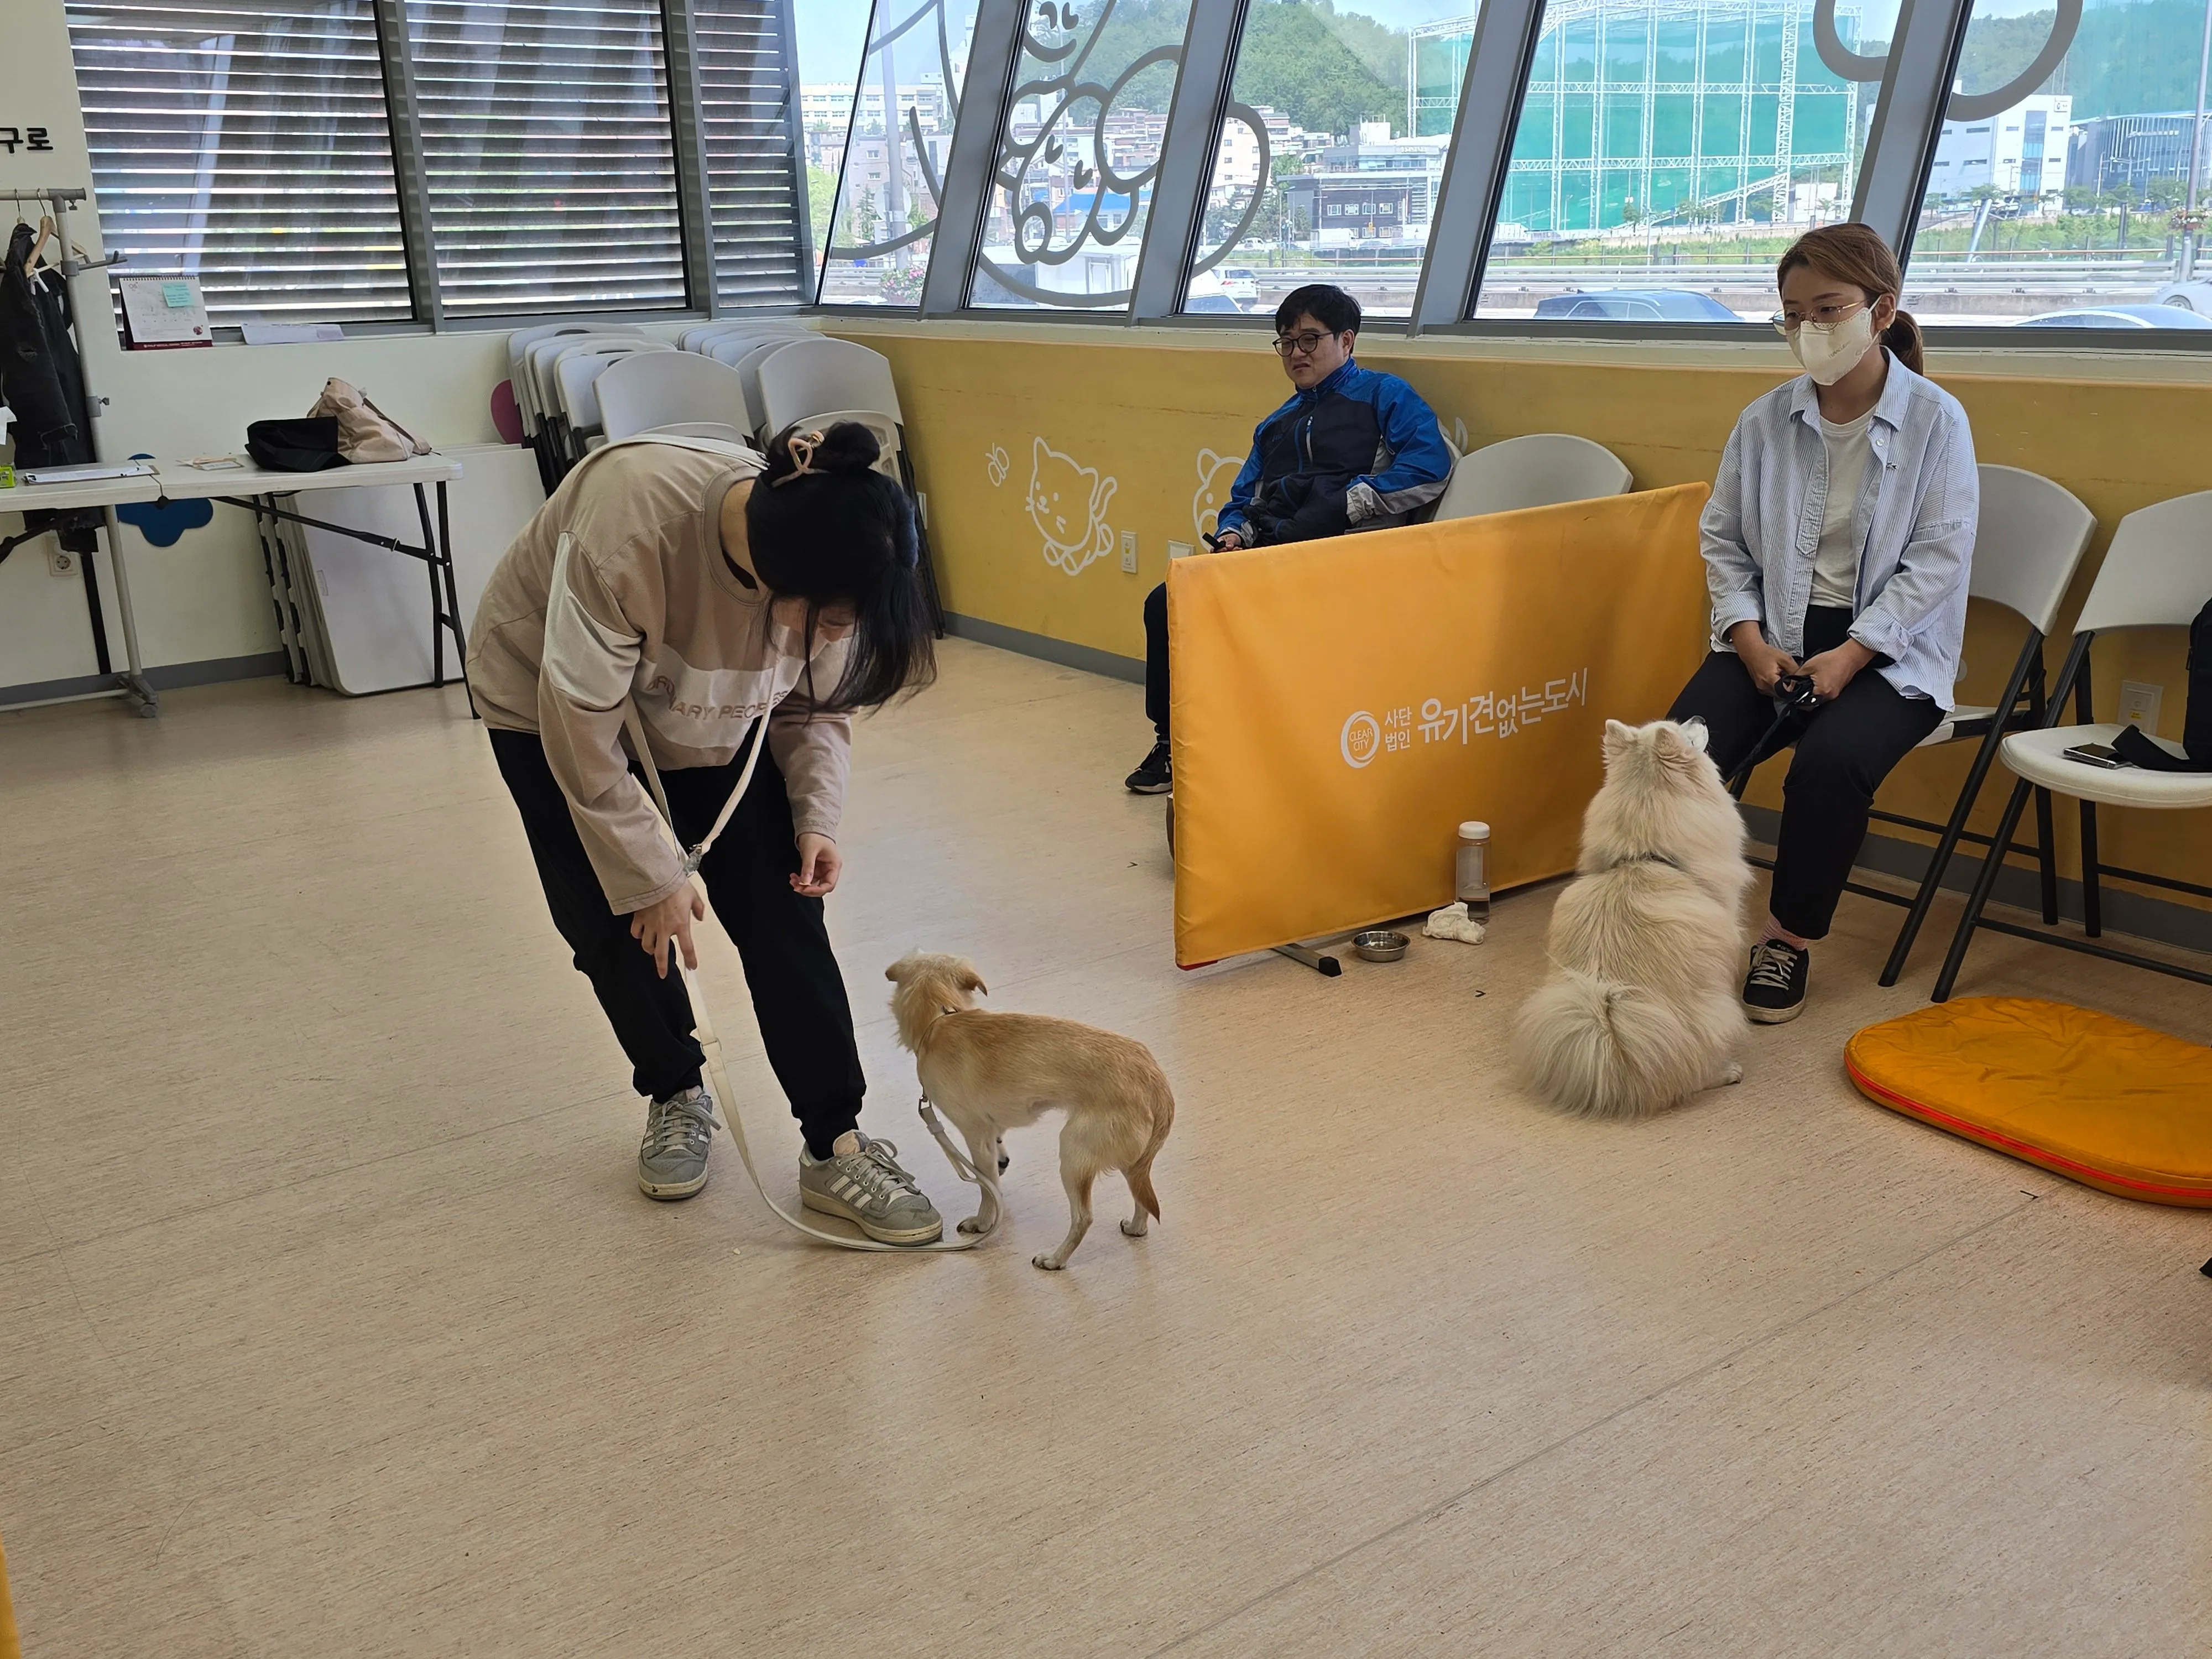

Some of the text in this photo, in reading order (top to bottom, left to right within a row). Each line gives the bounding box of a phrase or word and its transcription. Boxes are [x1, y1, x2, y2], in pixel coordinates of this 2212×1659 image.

[0, 127, 54, 154] 구로
[1384, 706, 1412, 728] 사단
[1349, 727, 1374, 742] CLEAR
[1353, 738, 1370, 752] CITY
[1385, 729, 1411, 752] 법인
